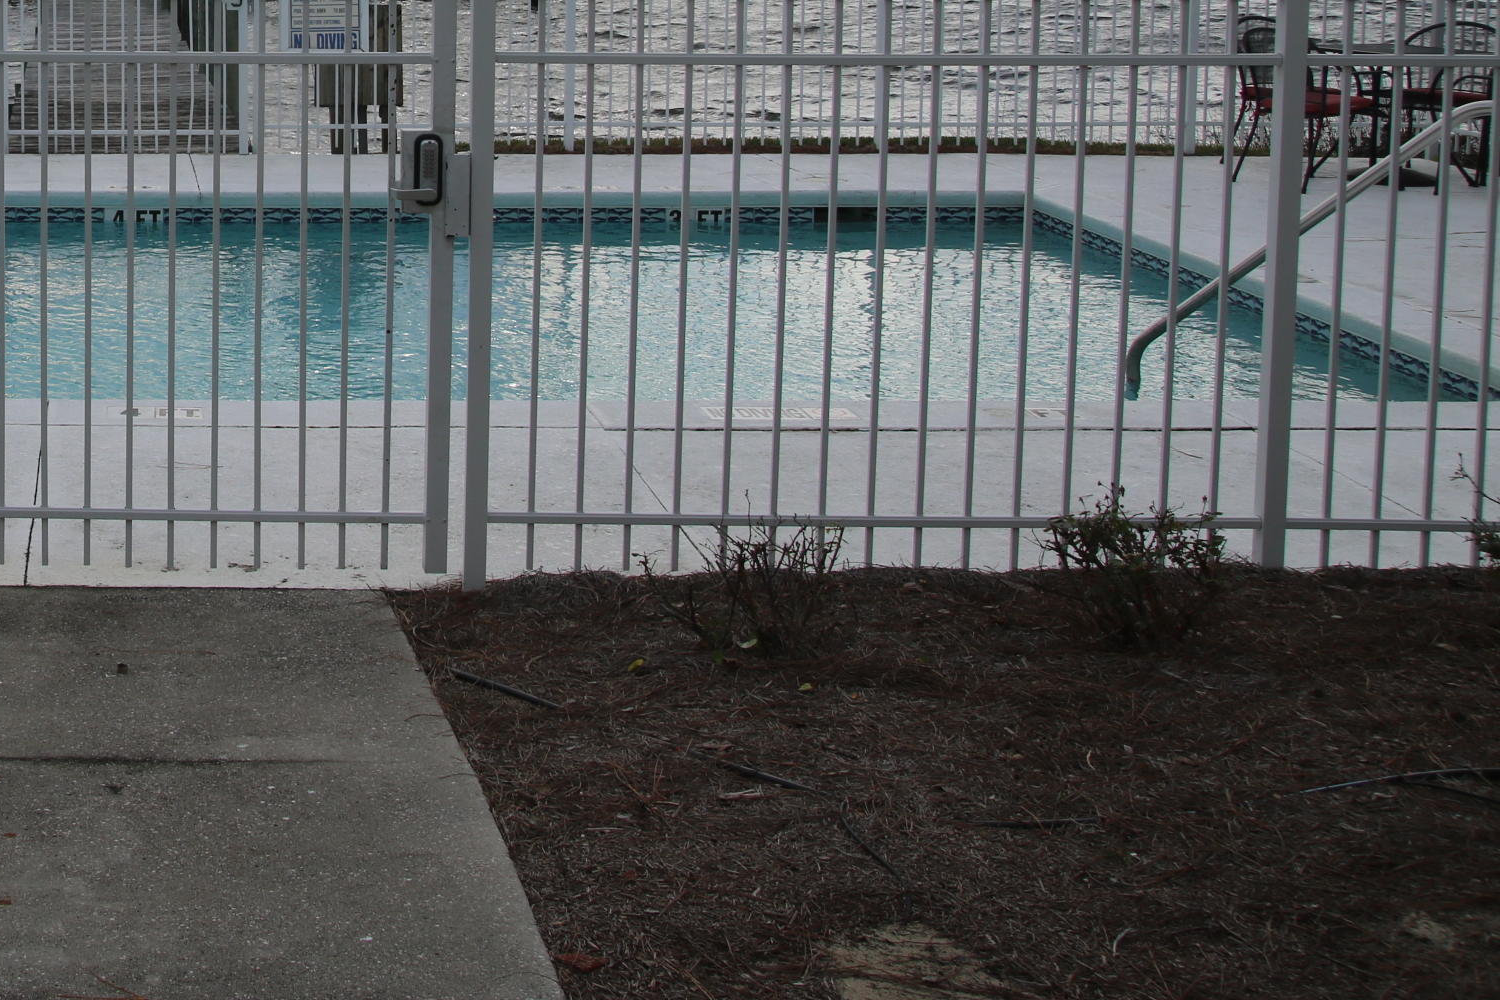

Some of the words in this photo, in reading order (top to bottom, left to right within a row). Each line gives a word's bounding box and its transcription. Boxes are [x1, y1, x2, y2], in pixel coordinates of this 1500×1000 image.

[293, 33, 311, 49] N
[135, 209, 161, 223] FT
[697, 209, 723, 223] FT
